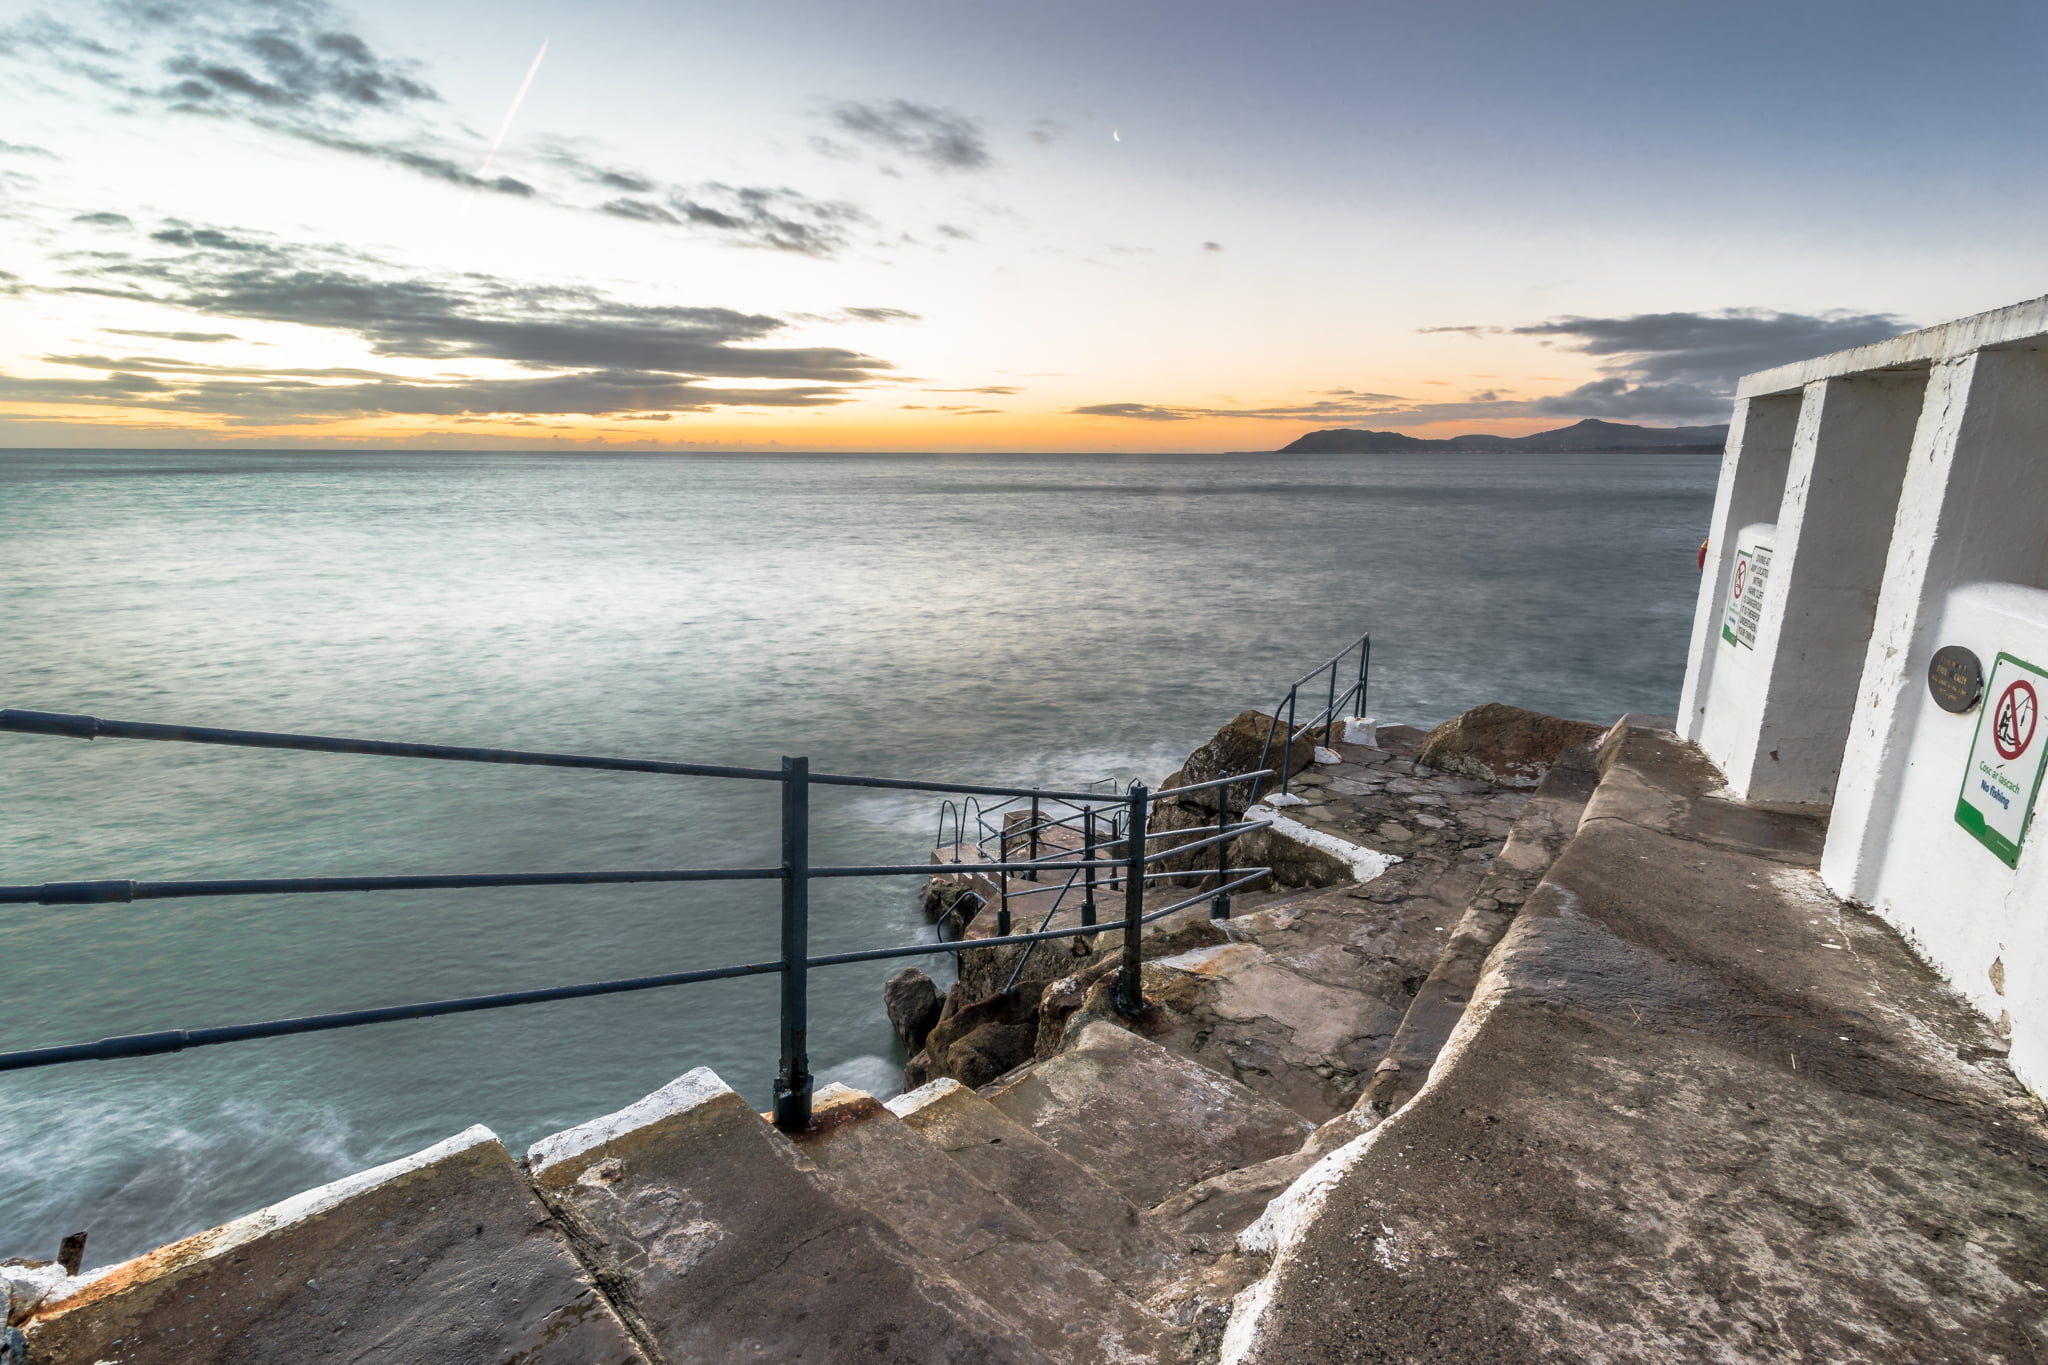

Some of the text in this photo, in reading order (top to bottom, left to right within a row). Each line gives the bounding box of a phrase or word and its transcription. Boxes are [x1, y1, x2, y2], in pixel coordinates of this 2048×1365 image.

[1980, 761, 1992, 776] Cosc
[1981, 779, 2010, 810] No fishing
